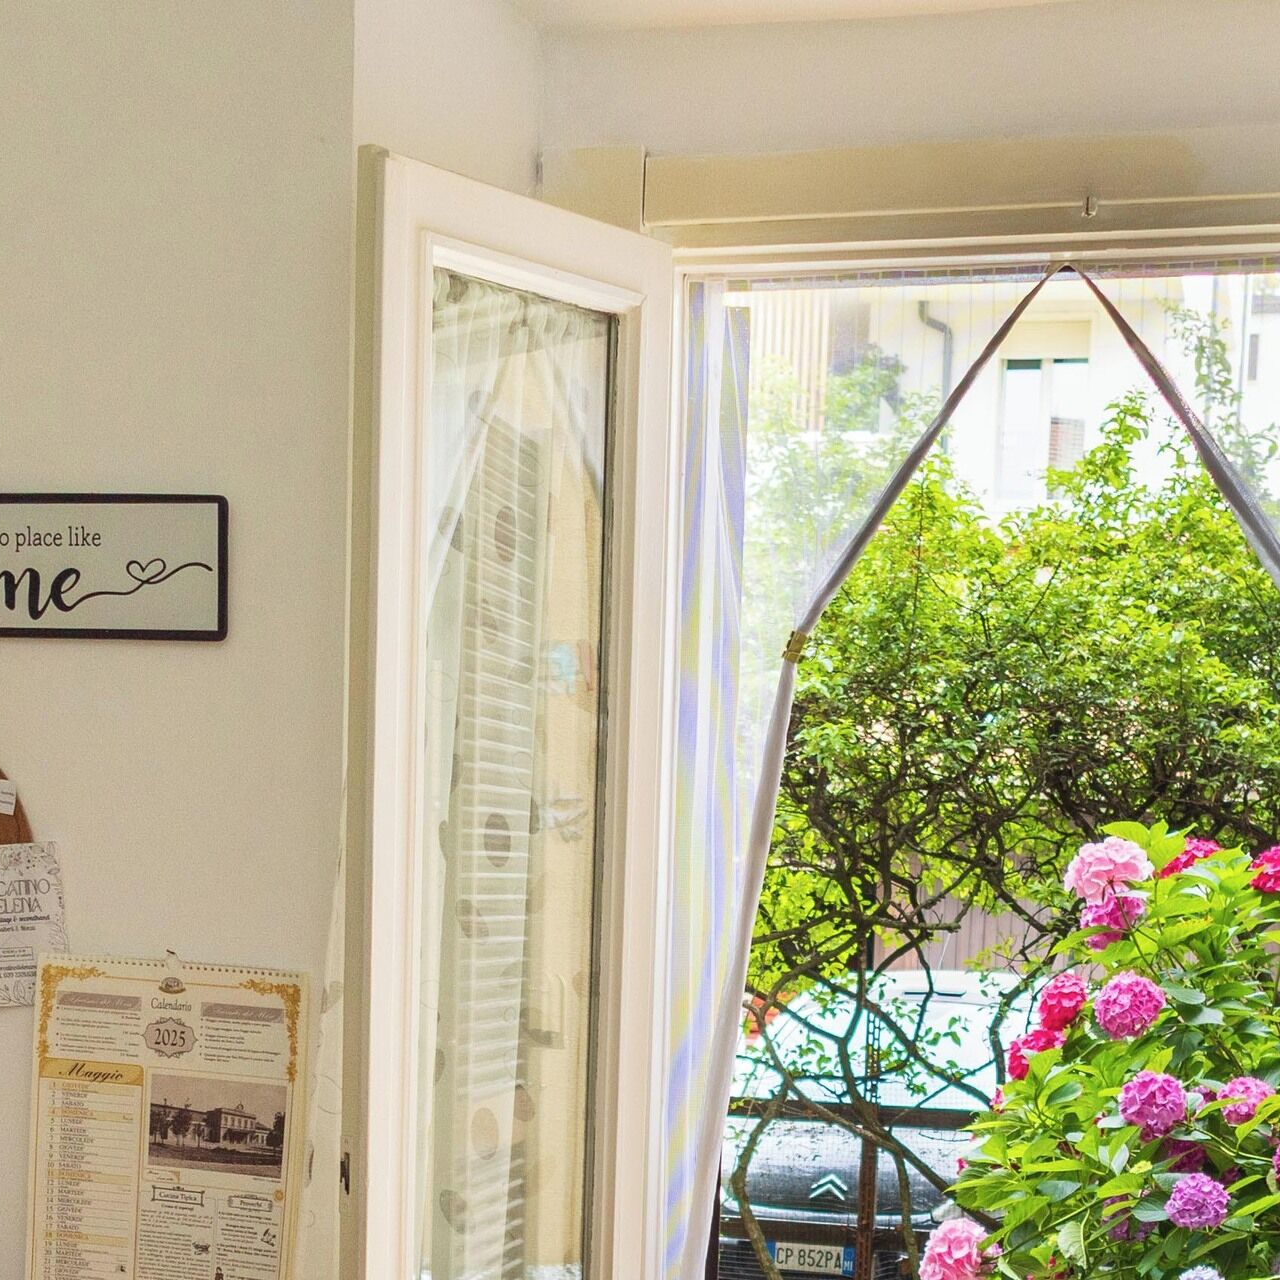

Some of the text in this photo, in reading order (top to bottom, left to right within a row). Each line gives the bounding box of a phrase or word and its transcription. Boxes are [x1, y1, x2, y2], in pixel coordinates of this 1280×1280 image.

[15, 527, 64, 552] place
[68, 526, 102, 547] like
[150, 997, 192, 1012] Calendario
[154, 1028, 186, 1047] 2025
[66, 1062, 123, 1083] Maggio
[776, 1247, 842, 1269] CP 852PA
